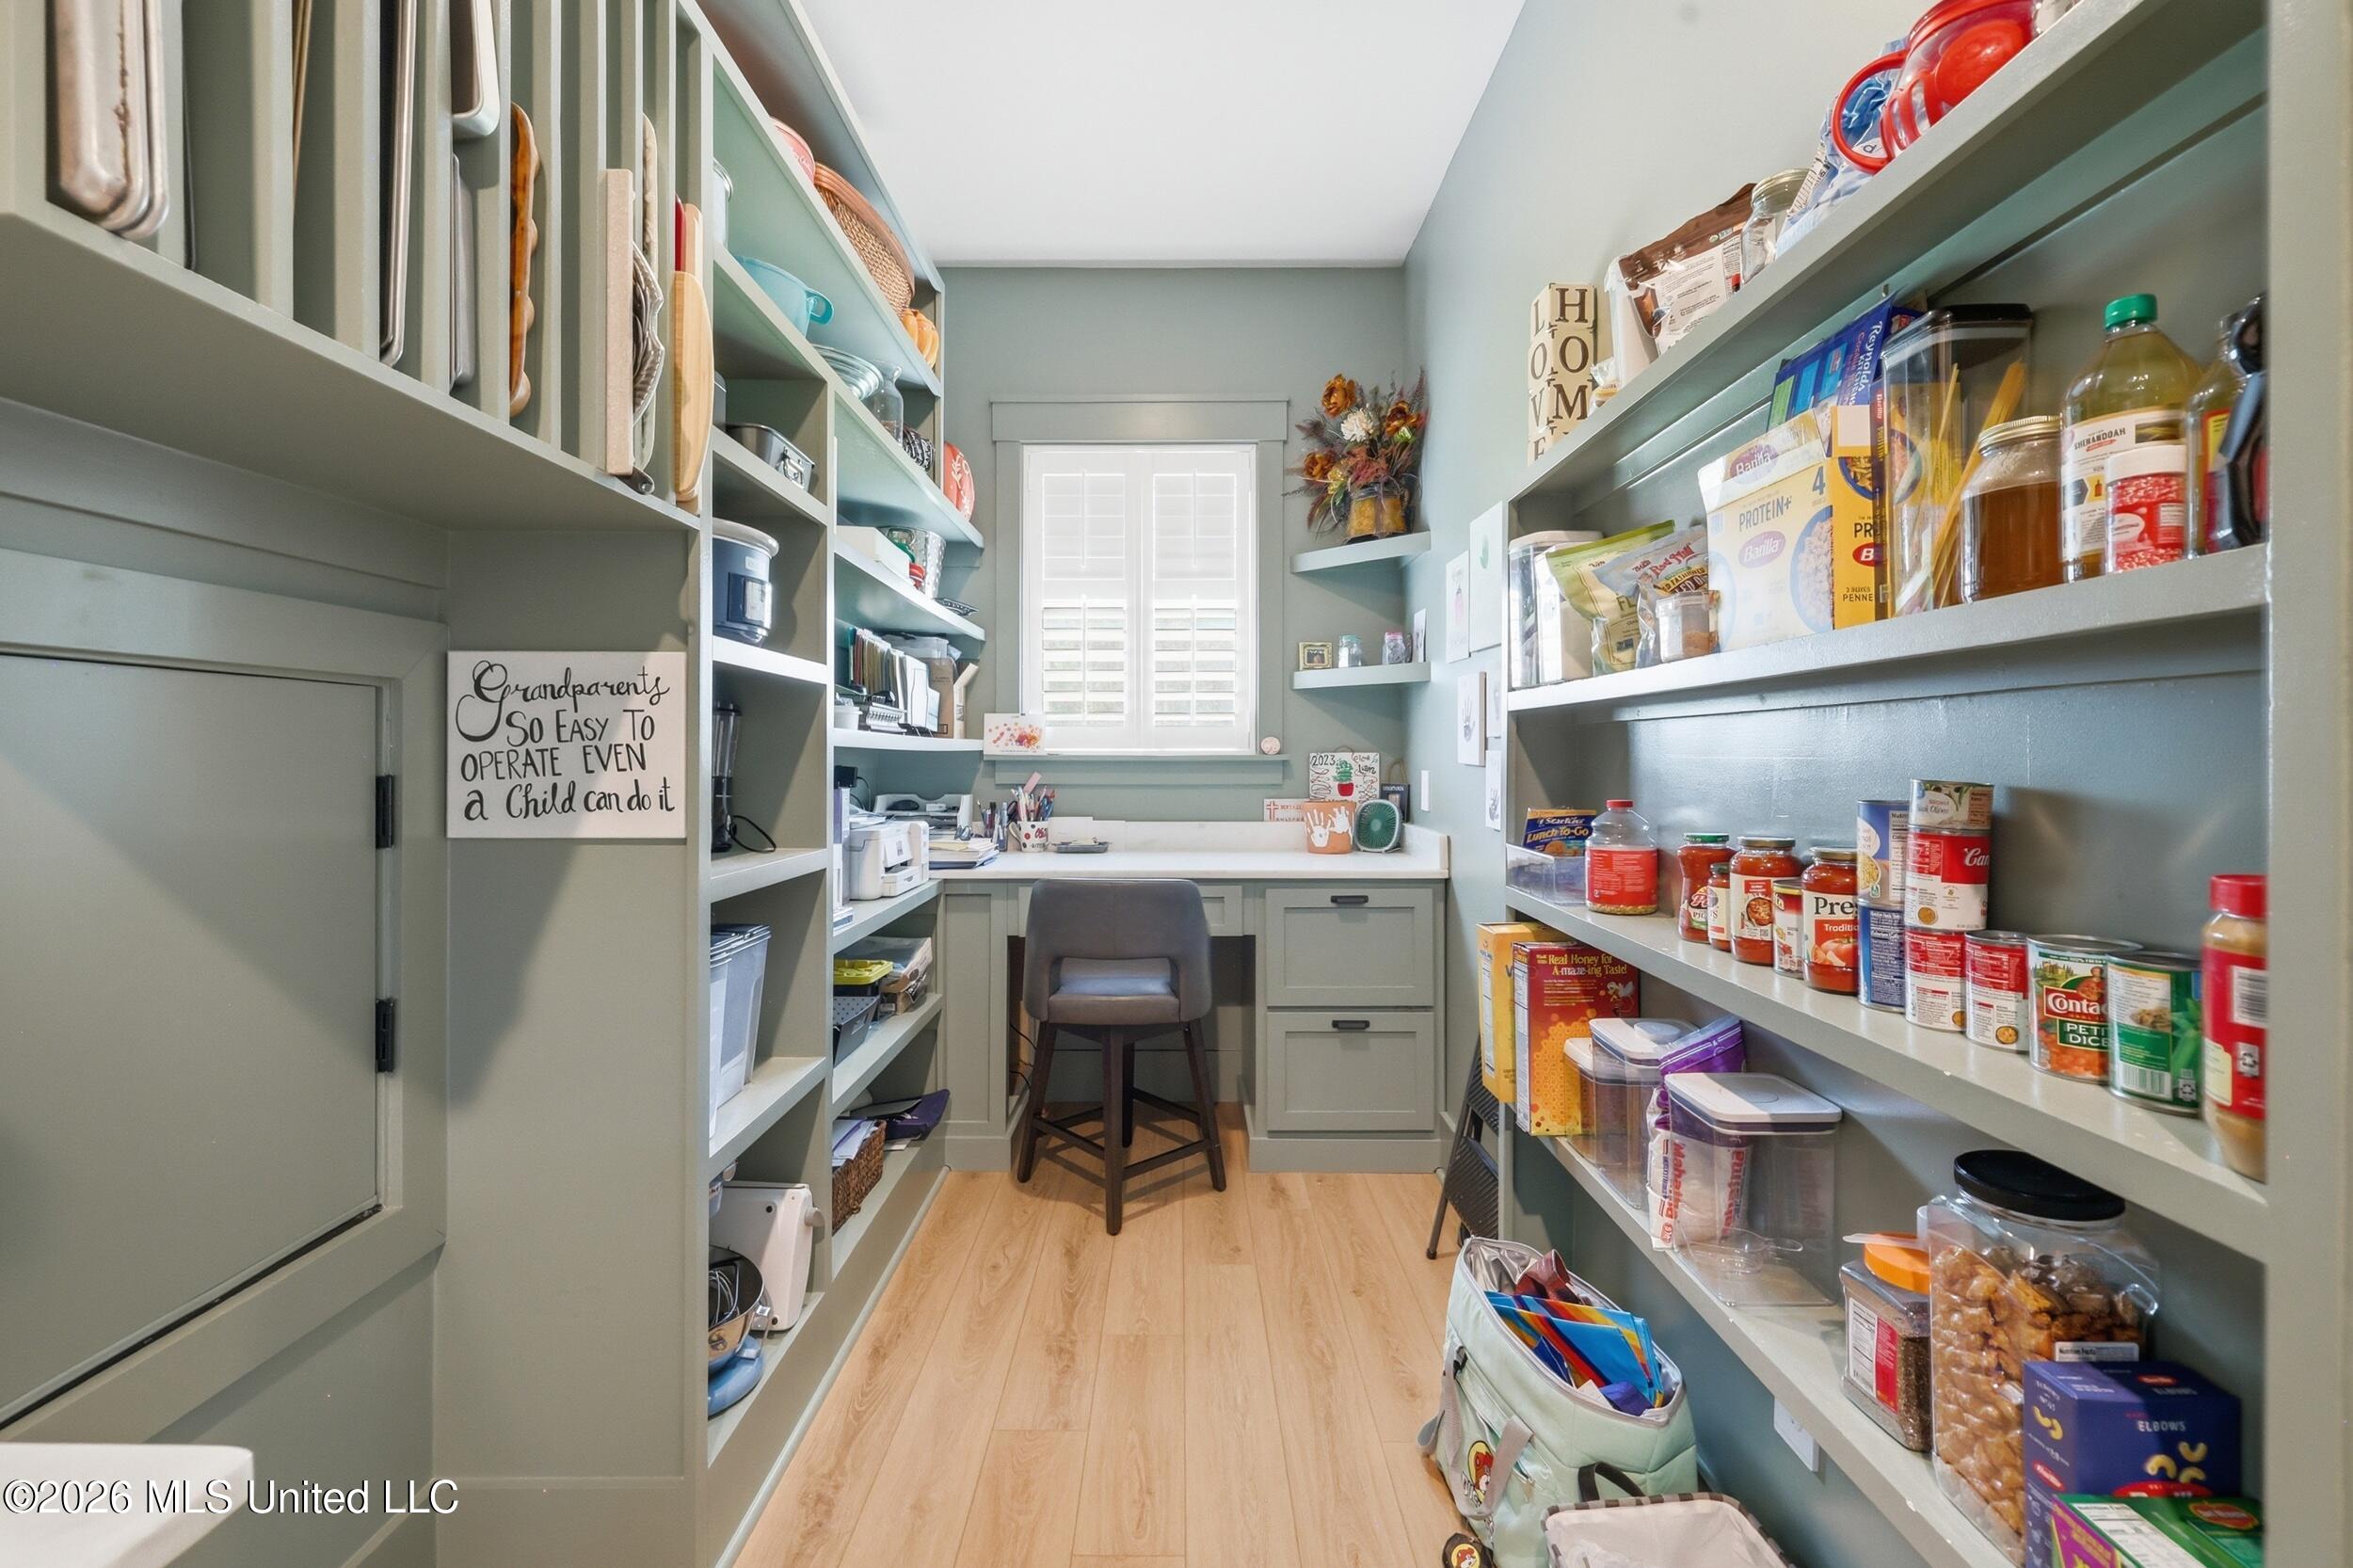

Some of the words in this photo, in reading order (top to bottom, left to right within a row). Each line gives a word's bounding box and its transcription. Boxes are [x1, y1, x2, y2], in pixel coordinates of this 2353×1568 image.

[1553, 288, 1590, 421] HOM
[1857, 321, 1883, 392] Reynolds
[1530, 299, 1548, 461] LOVE
[2073, 427, 2126, 450] SHENANDOAH
[1735, 447, 1771, 475] Barilla
[1812, 465, 1826, 496] 4
[1738, 495, 1793, 532] PROTEIN+
[1742, 536, 1781, 564] Barilla
[1842, 593, 1874, 602] PENNE
[456, 660, 670, 743] Grandparents
[505, 711, 544, 747] SO
[555, 708, 610, 744] EASY
[622, 709, 656, 742] TO
[460, 746, 563, 782] OPERATE
[582, 743, 647, 775] EVEN
[1311, 754, 1337, 767] 2023
[463, 789, 489, 822] a
[505, 780, 577, 820] Child
[583, 790, 624, 813] can
[626, 778, 652, 812] do
[658, 776, 676, 812] it
[1814, 896, 1858, 916] Pre
[1548, 953, 1568, 965] Real
[1571, 952, 1599, 967] Honey
[1601, 952, 1613, 965] for
[2069, 1033, 2109, 1048] DICE
[2137, 1419, 2186, 1432] ELBOWS
